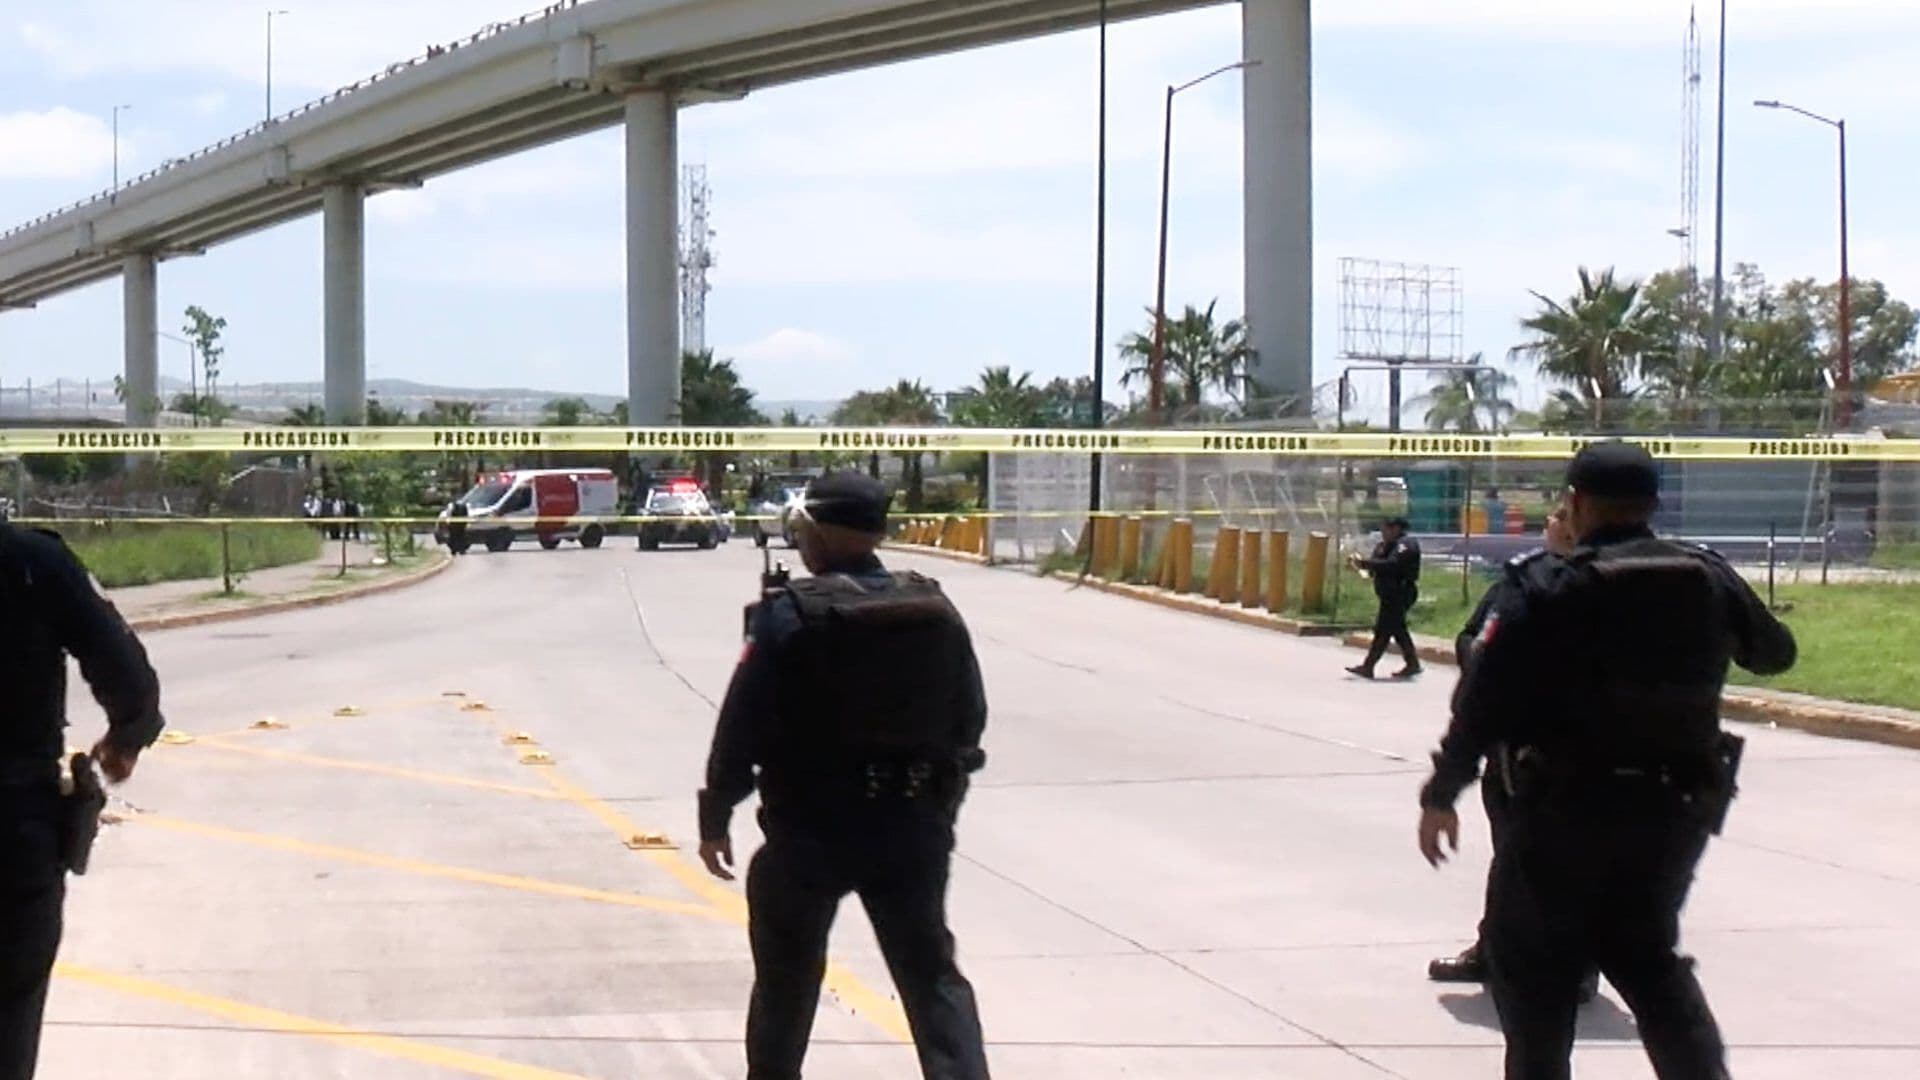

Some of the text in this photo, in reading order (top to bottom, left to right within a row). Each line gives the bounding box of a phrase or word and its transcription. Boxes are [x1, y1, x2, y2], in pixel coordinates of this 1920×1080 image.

[58, 433, 161, 447] PRECAUCION
[244, 432, 349, 446] PRECAUCION
[434, 431, 541, 445] PRECAUCION
[627, 431, 735, 445] PRECAUCION
[820, 433, 927, 446] PRECAUCION
[1012, 434, 1120, 447] PRECAUCION
[1202, 437, 1306, 450] PRECAUCION
[1389, 438, 1491, 452] PRECAUCION
[1749, 441, 1849, 455] PRECAUCION
